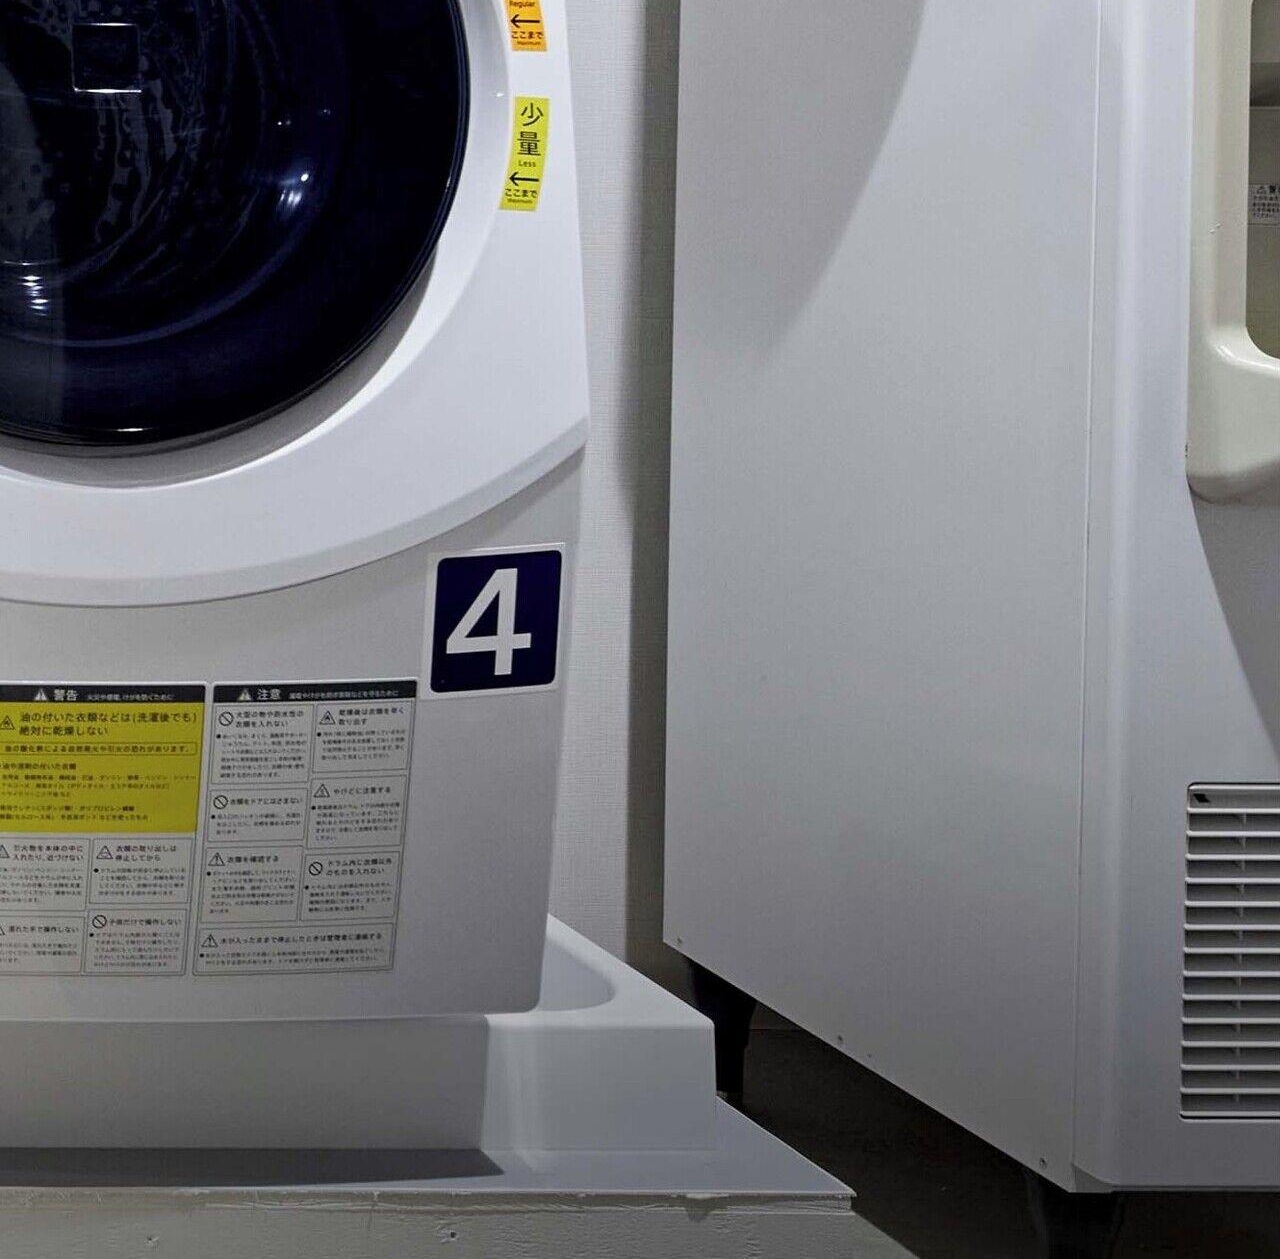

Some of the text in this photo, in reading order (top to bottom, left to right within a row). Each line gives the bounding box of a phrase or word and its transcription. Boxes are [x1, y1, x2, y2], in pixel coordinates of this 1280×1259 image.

[508, 0, 536, 9] Regular
[511, 30, 544, 40] ここまで
[517, 102, 544, 156] 少量
[518, 160, 537, 168] Less
[505, 188, 538, 199] ここまで
[446, 567, 532, 676] 4
[53, 689, 78, 702] 警告
[255, 688, 281, 701] 注意
[18, 726, 109, 737] 絶対に乾燥しない
